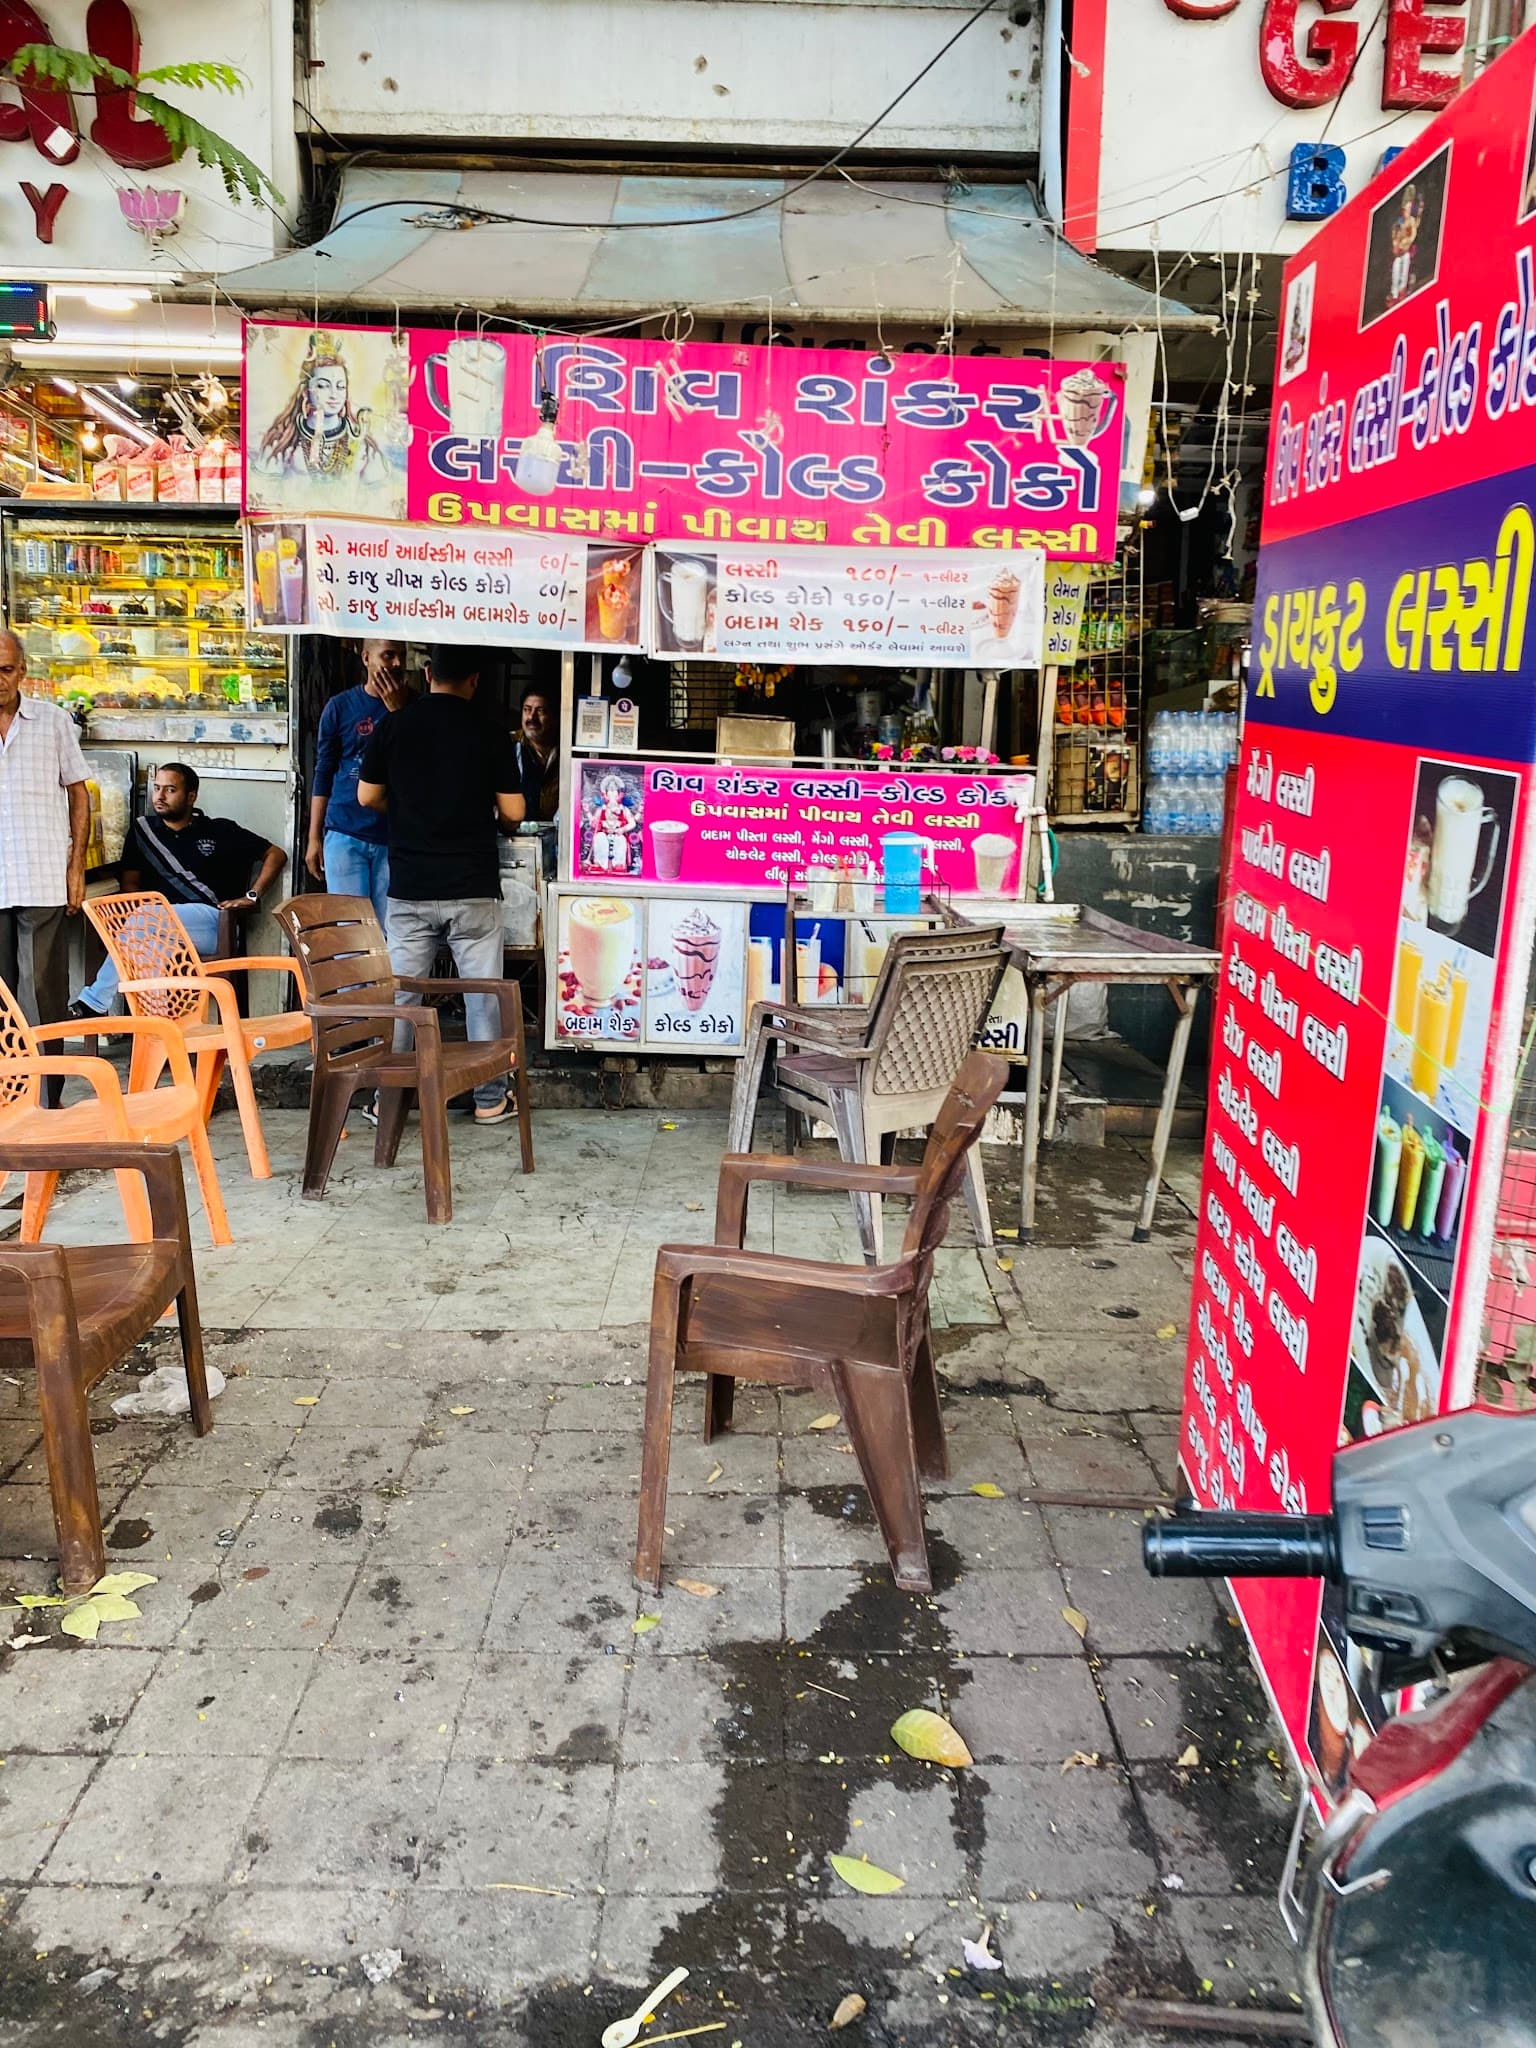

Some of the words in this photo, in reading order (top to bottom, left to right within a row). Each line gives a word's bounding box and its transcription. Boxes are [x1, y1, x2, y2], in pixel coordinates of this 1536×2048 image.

[532, 342, 741, 420] શિવ
[794, 356, 1044, 432] શંકર
[921, 440, 1100, 513] કોકો
[427, 491, 661, 536] ઉપવાસમાં
[682, 506, 828, 543] પીવાય
[851, 511, 948, 549] તેવી
[971, 520, 1099, 553] લસ્સી
[347, 538, 389, 559] મલાઈ
[395, 541, 466, 564] આઈસ્કીમ
[473, 546, 514, 568] લસ્સી
[347, 570, 379, 594] કાજુ
[385, 568, 424, 589] ચીપ્સ
[430, 570, 468, 592] કોલ્ડ
[475, 572, 512, 595] કોકો
[725, 558, 779, 579] લસ્સી
[725, 583, 776, 605] કોલ્ડ
[785, 584, 833, 606] કોકો
[1052, 577, 1081, 599] લેમન
[1384, 499, 1536, 674] લસ્સી
[347, 598, 379, 622] કાજુ
[385, 597, 456, 619] આઈસ્કીમ
[725, 615, 779, 631] બદામ
[789, 611, 825, 632] શેક
[1052, 604, 1077, 626] સોડા
[1048, 631, 1072, 653] સોડા
[652, 769, 704, 793] શિવ
[717, 772, 779, 796] શંકર
[791, 778, 946, 804] લસ્સી-કોલ્ડ
[1275, 763, 1315, 818] લસ્સી
[690, 800, 789, 821] ઉપવાસમાં
[799, 804, 863, 826] પીવાય
[871, 807, 914, 826] તેવી
[923, 812, 980, 829] લસ્સી
[700, 829, 731, 841] બદામ
[725, 845, 766, 861] ચોકલેટ
[1288, 846, 1332, 904] લસ્સી
[1315, 941, 1363, 1008] લસ્સી
[565, 1015, 602, 1031] બદામ
[609, 1012, 640, 1033] શેક
[654, 1013, 692, 1033] કોલ્ડ
[700, 1014, 734, 1034] કોકો
[1302, 1012, 1349, 1082] લસ્સી
[1247, 1037, 1283, 1101] લસ્સી
[1261, 1126, 1300, 1199] લસ્સી
[1276, 1222, 1318, 1305] લસ્સી
[1268, 1288, 1309, 1376] લસ્સી
